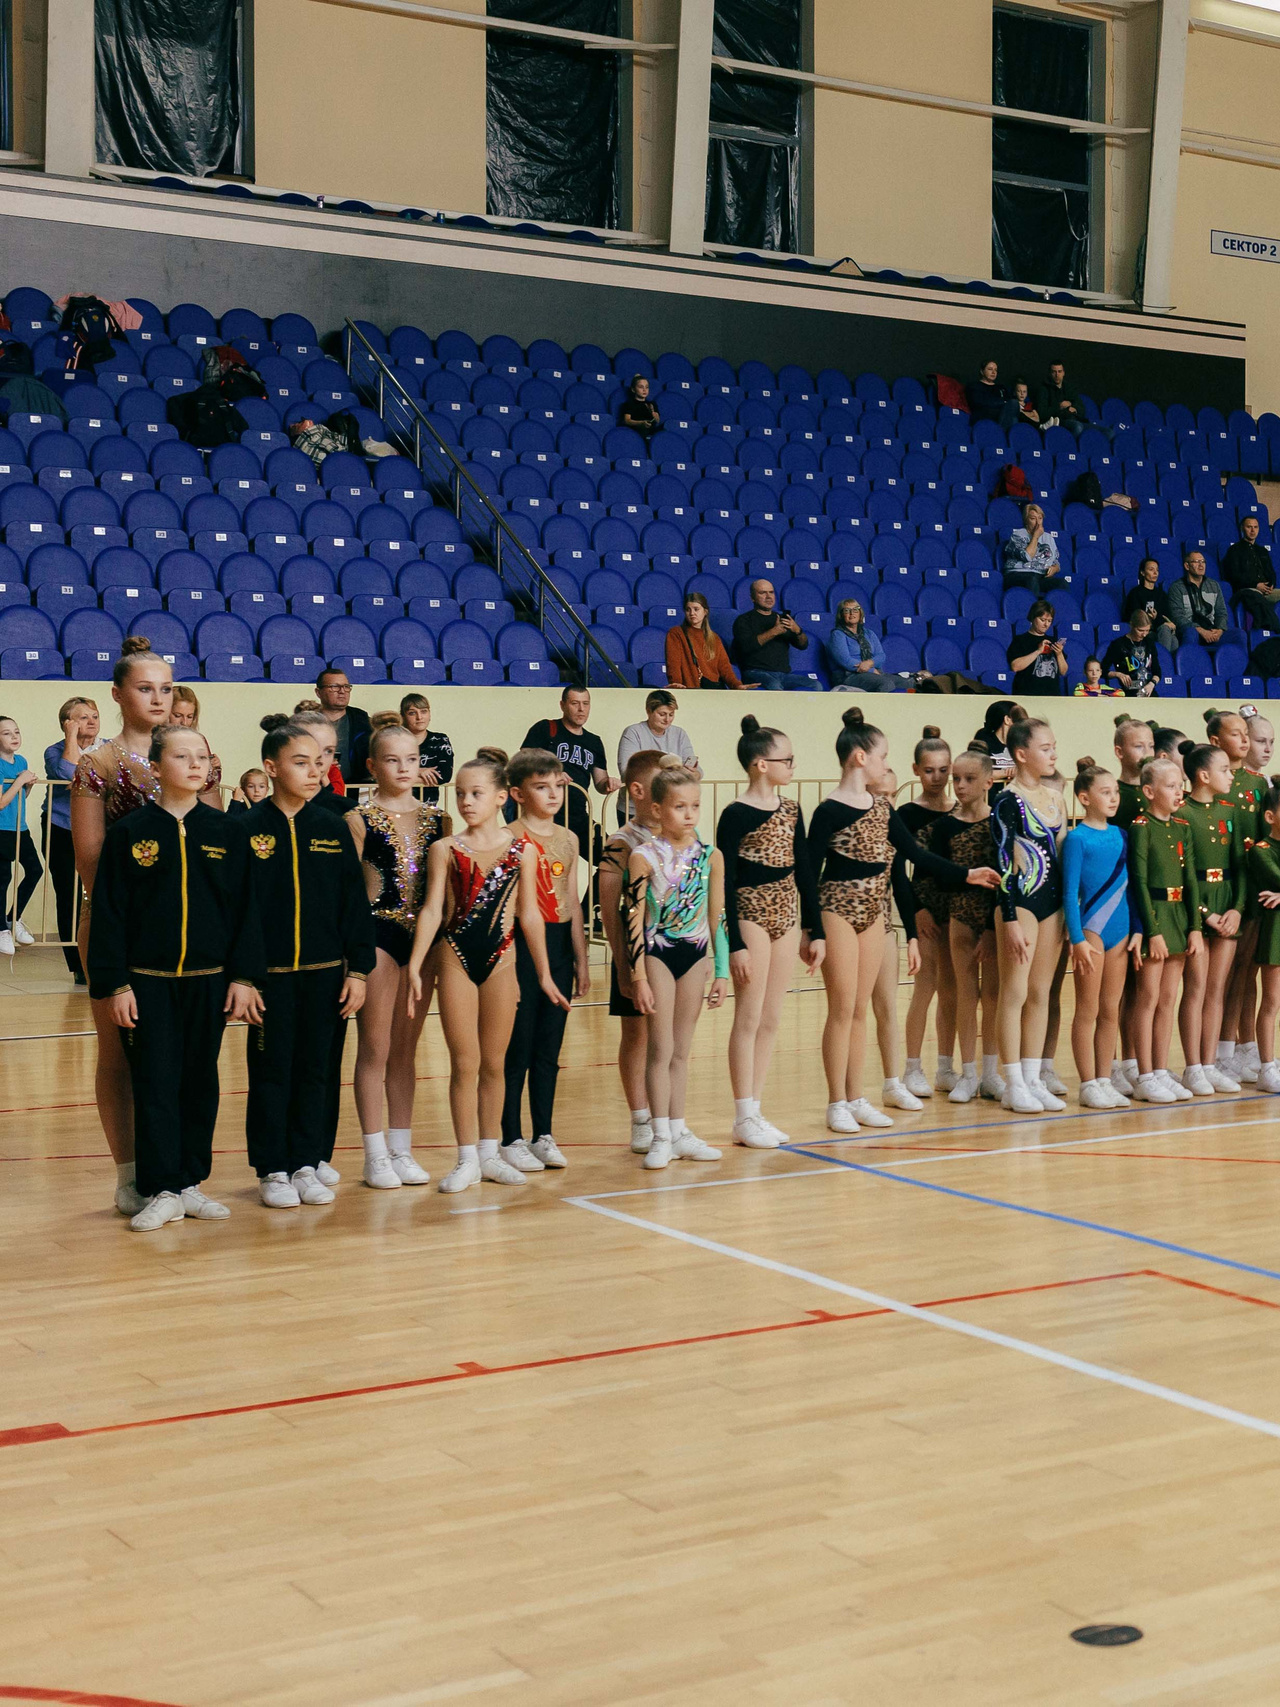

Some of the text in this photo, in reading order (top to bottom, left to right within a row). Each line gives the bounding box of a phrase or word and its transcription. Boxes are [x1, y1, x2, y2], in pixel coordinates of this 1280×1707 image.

[1223, 238, 1277, 257] СЕКТОР 2
[557, 742, 594, 770] GAP
